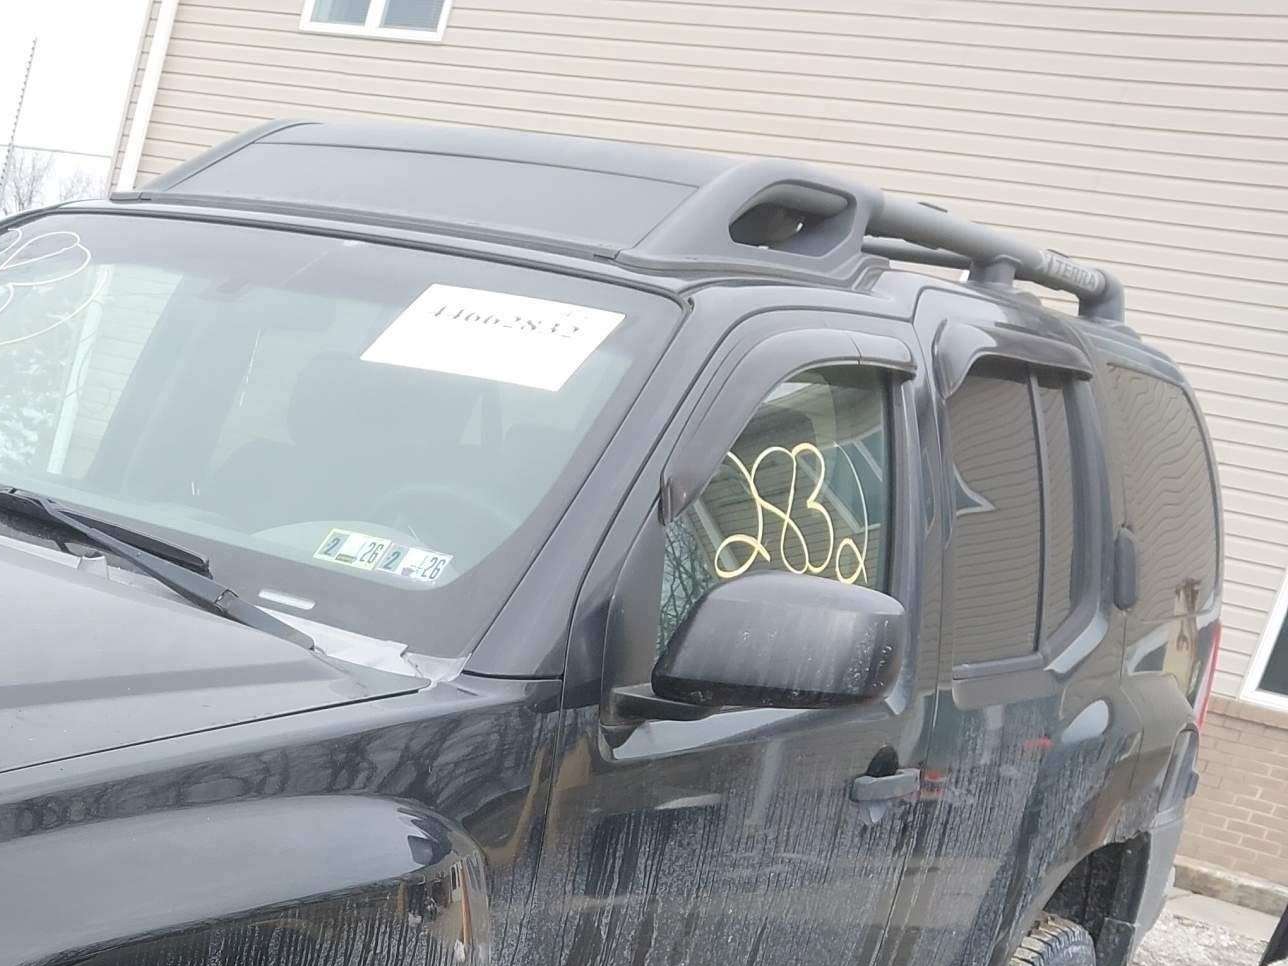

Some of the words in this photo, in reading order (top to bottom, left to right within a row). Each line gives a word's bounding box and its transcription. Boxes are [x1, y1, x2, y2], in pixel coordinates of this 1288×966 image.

[324, 537, 341, 556] 2
[359, 541, 385, 564] 26
[383, 551, 401, 570] 2
[420, 556, 446, 580] 26
